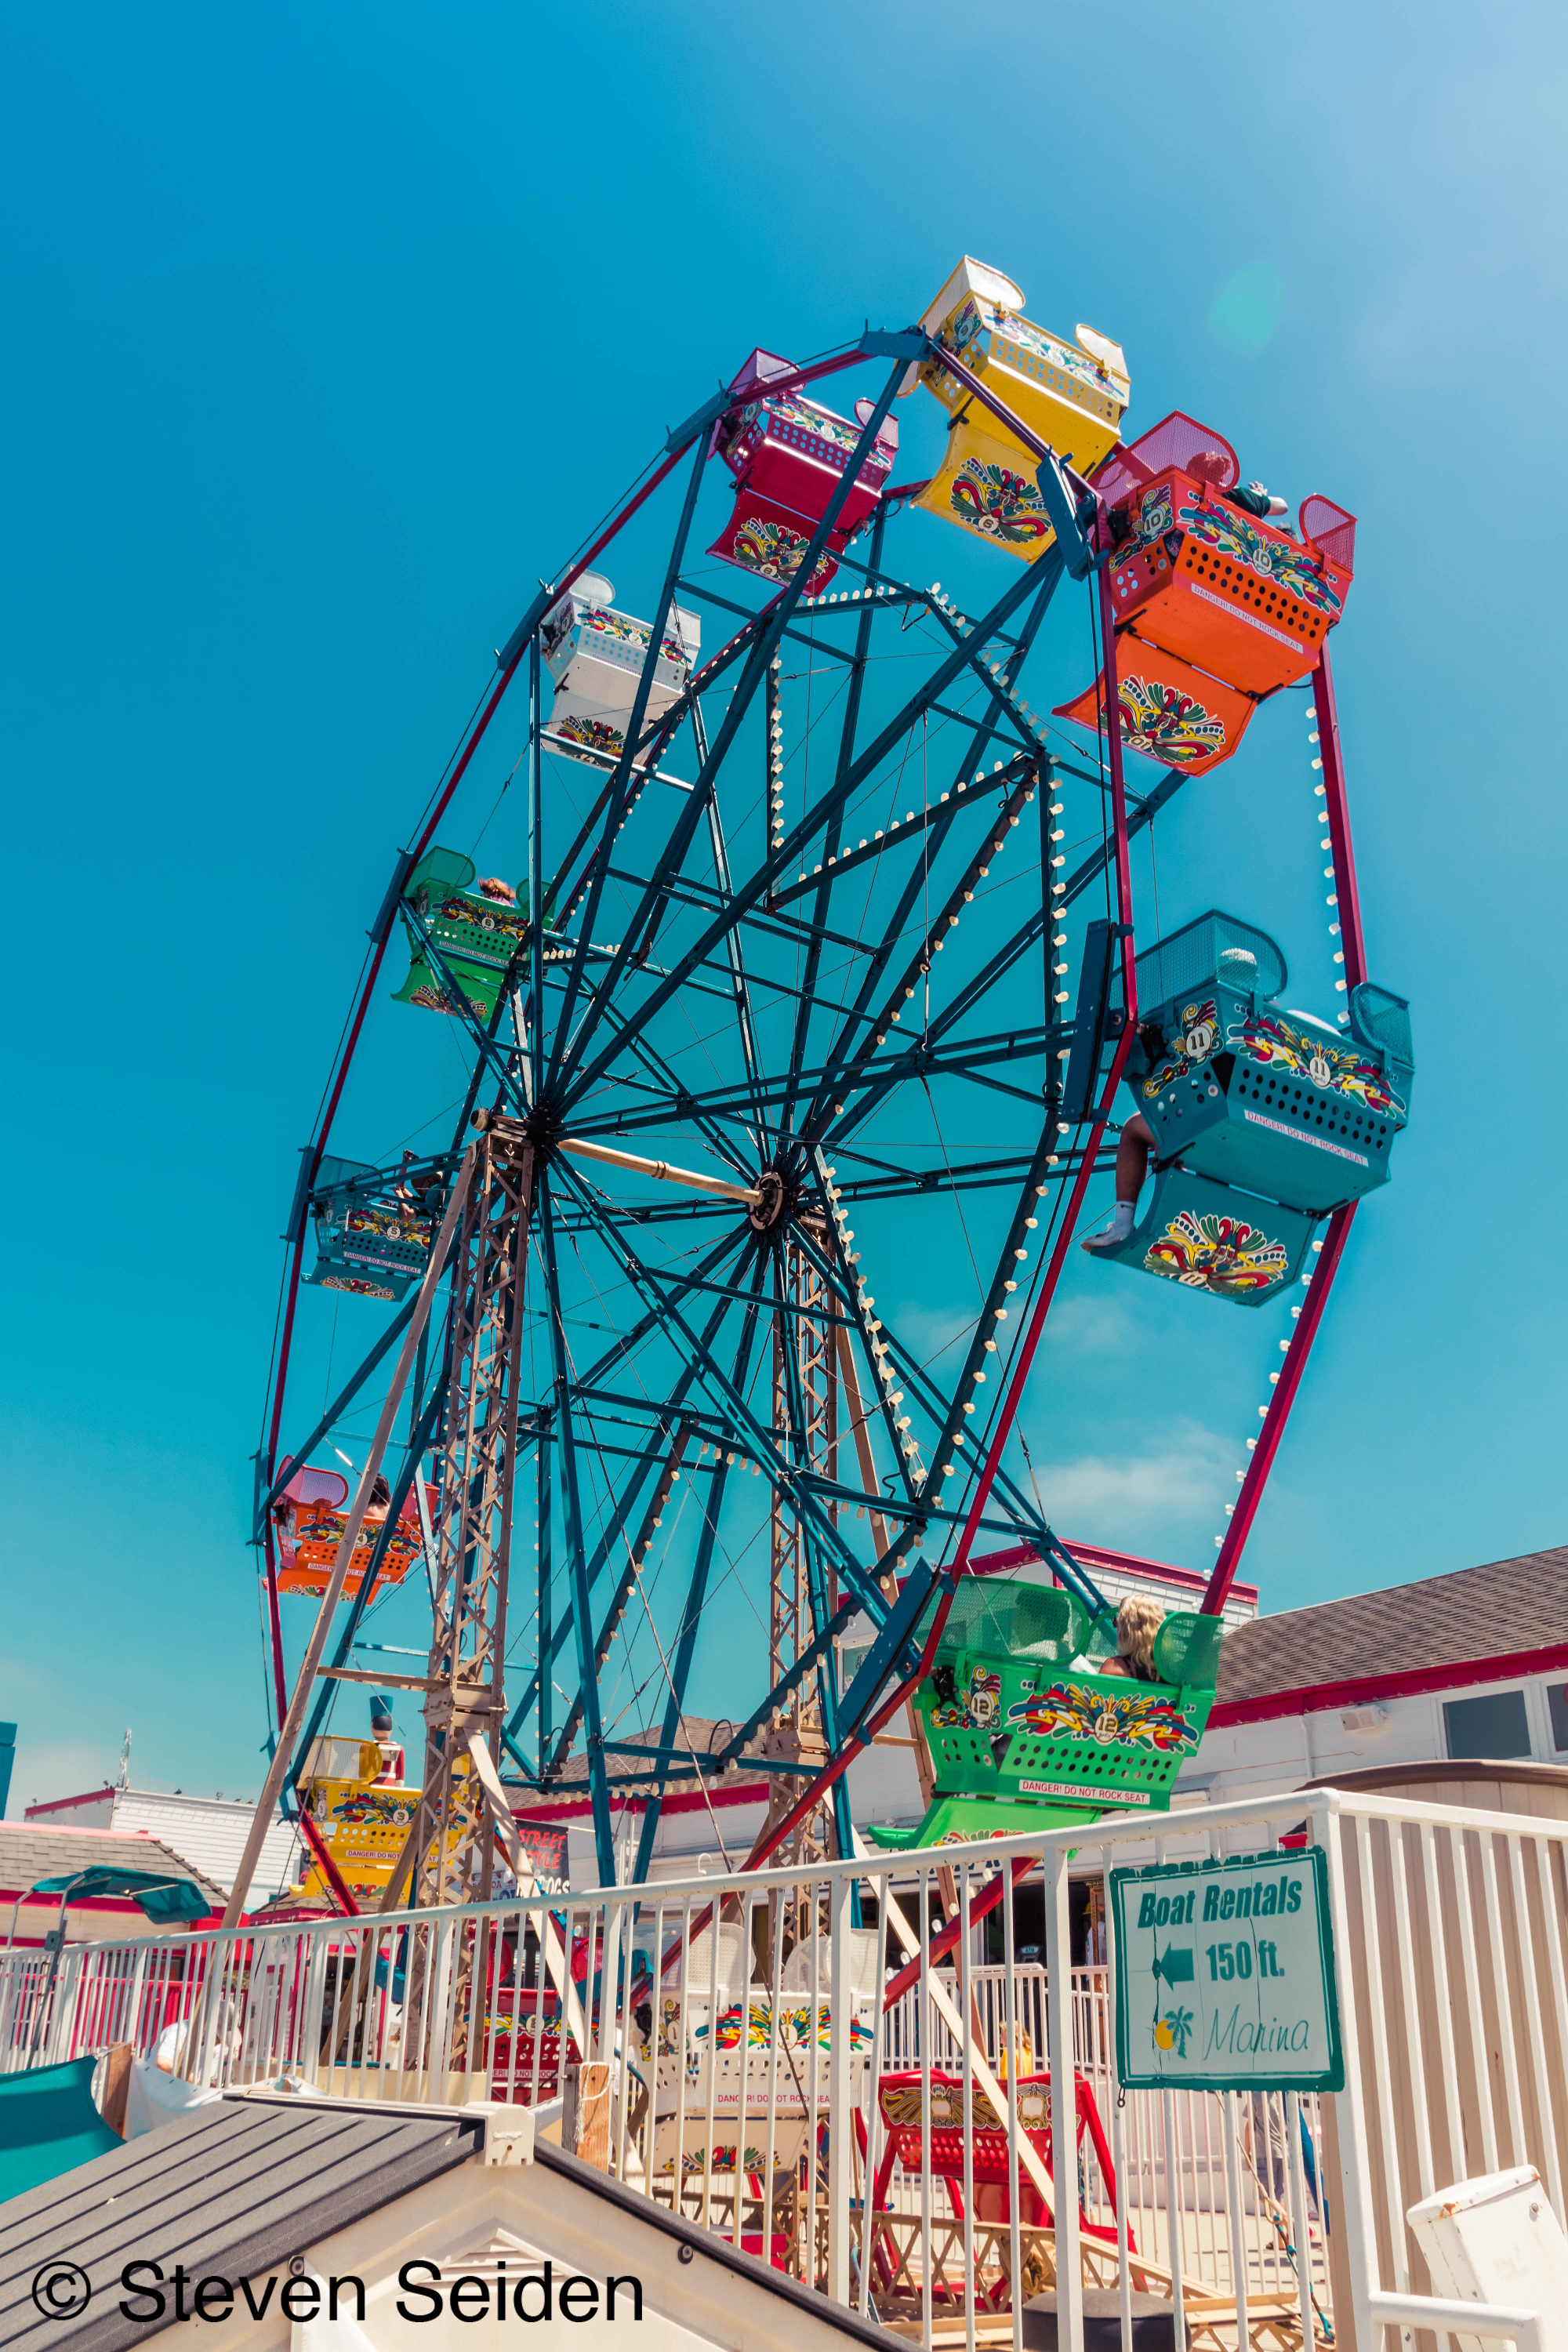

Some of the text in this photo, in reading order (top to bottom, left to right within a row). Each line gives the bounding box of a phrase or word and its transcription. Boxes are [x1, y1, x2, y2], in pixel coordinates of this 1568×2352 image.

[1145, 516, 1160, 531] 10
[1255, 553, 1269, 567] 10
[1195, 586, 1299, 650] DANGER! DO NOT ROCK SEAT
[441, 942, 464, 952] DANGER!
[1191, 1033, 1205, 1050] 11
[1314, 1059, 1326, 1076] 11
[1247, 1111, 1364, 1165] DANGER! DO NOT ROCK SEAT
[347, 1252, 369, 1261] DANGER!
[973, 1697, 989, 1715] 12
[1098, 1715, 1116, 1733] 12
[1022, 1780, 1145, 1803] DANGER! DO NOT ROCK SEAT
[396, 1812, 405, 1822] 3
[518, 1828, 566, 1850] STREET
[1138, 1875, 1302, 1929] Boat Rentals
[1205, 1940, 1285, 1981] 150 ft.
[1203, 2004, 1309, 2061] Marina
[718, 2094, 755, 2103] DANR!
[757, 2094, 769, 2103] DO
[775, 2094, 787, 2103] OT
[816, 2095, 830, 2103] SEA
